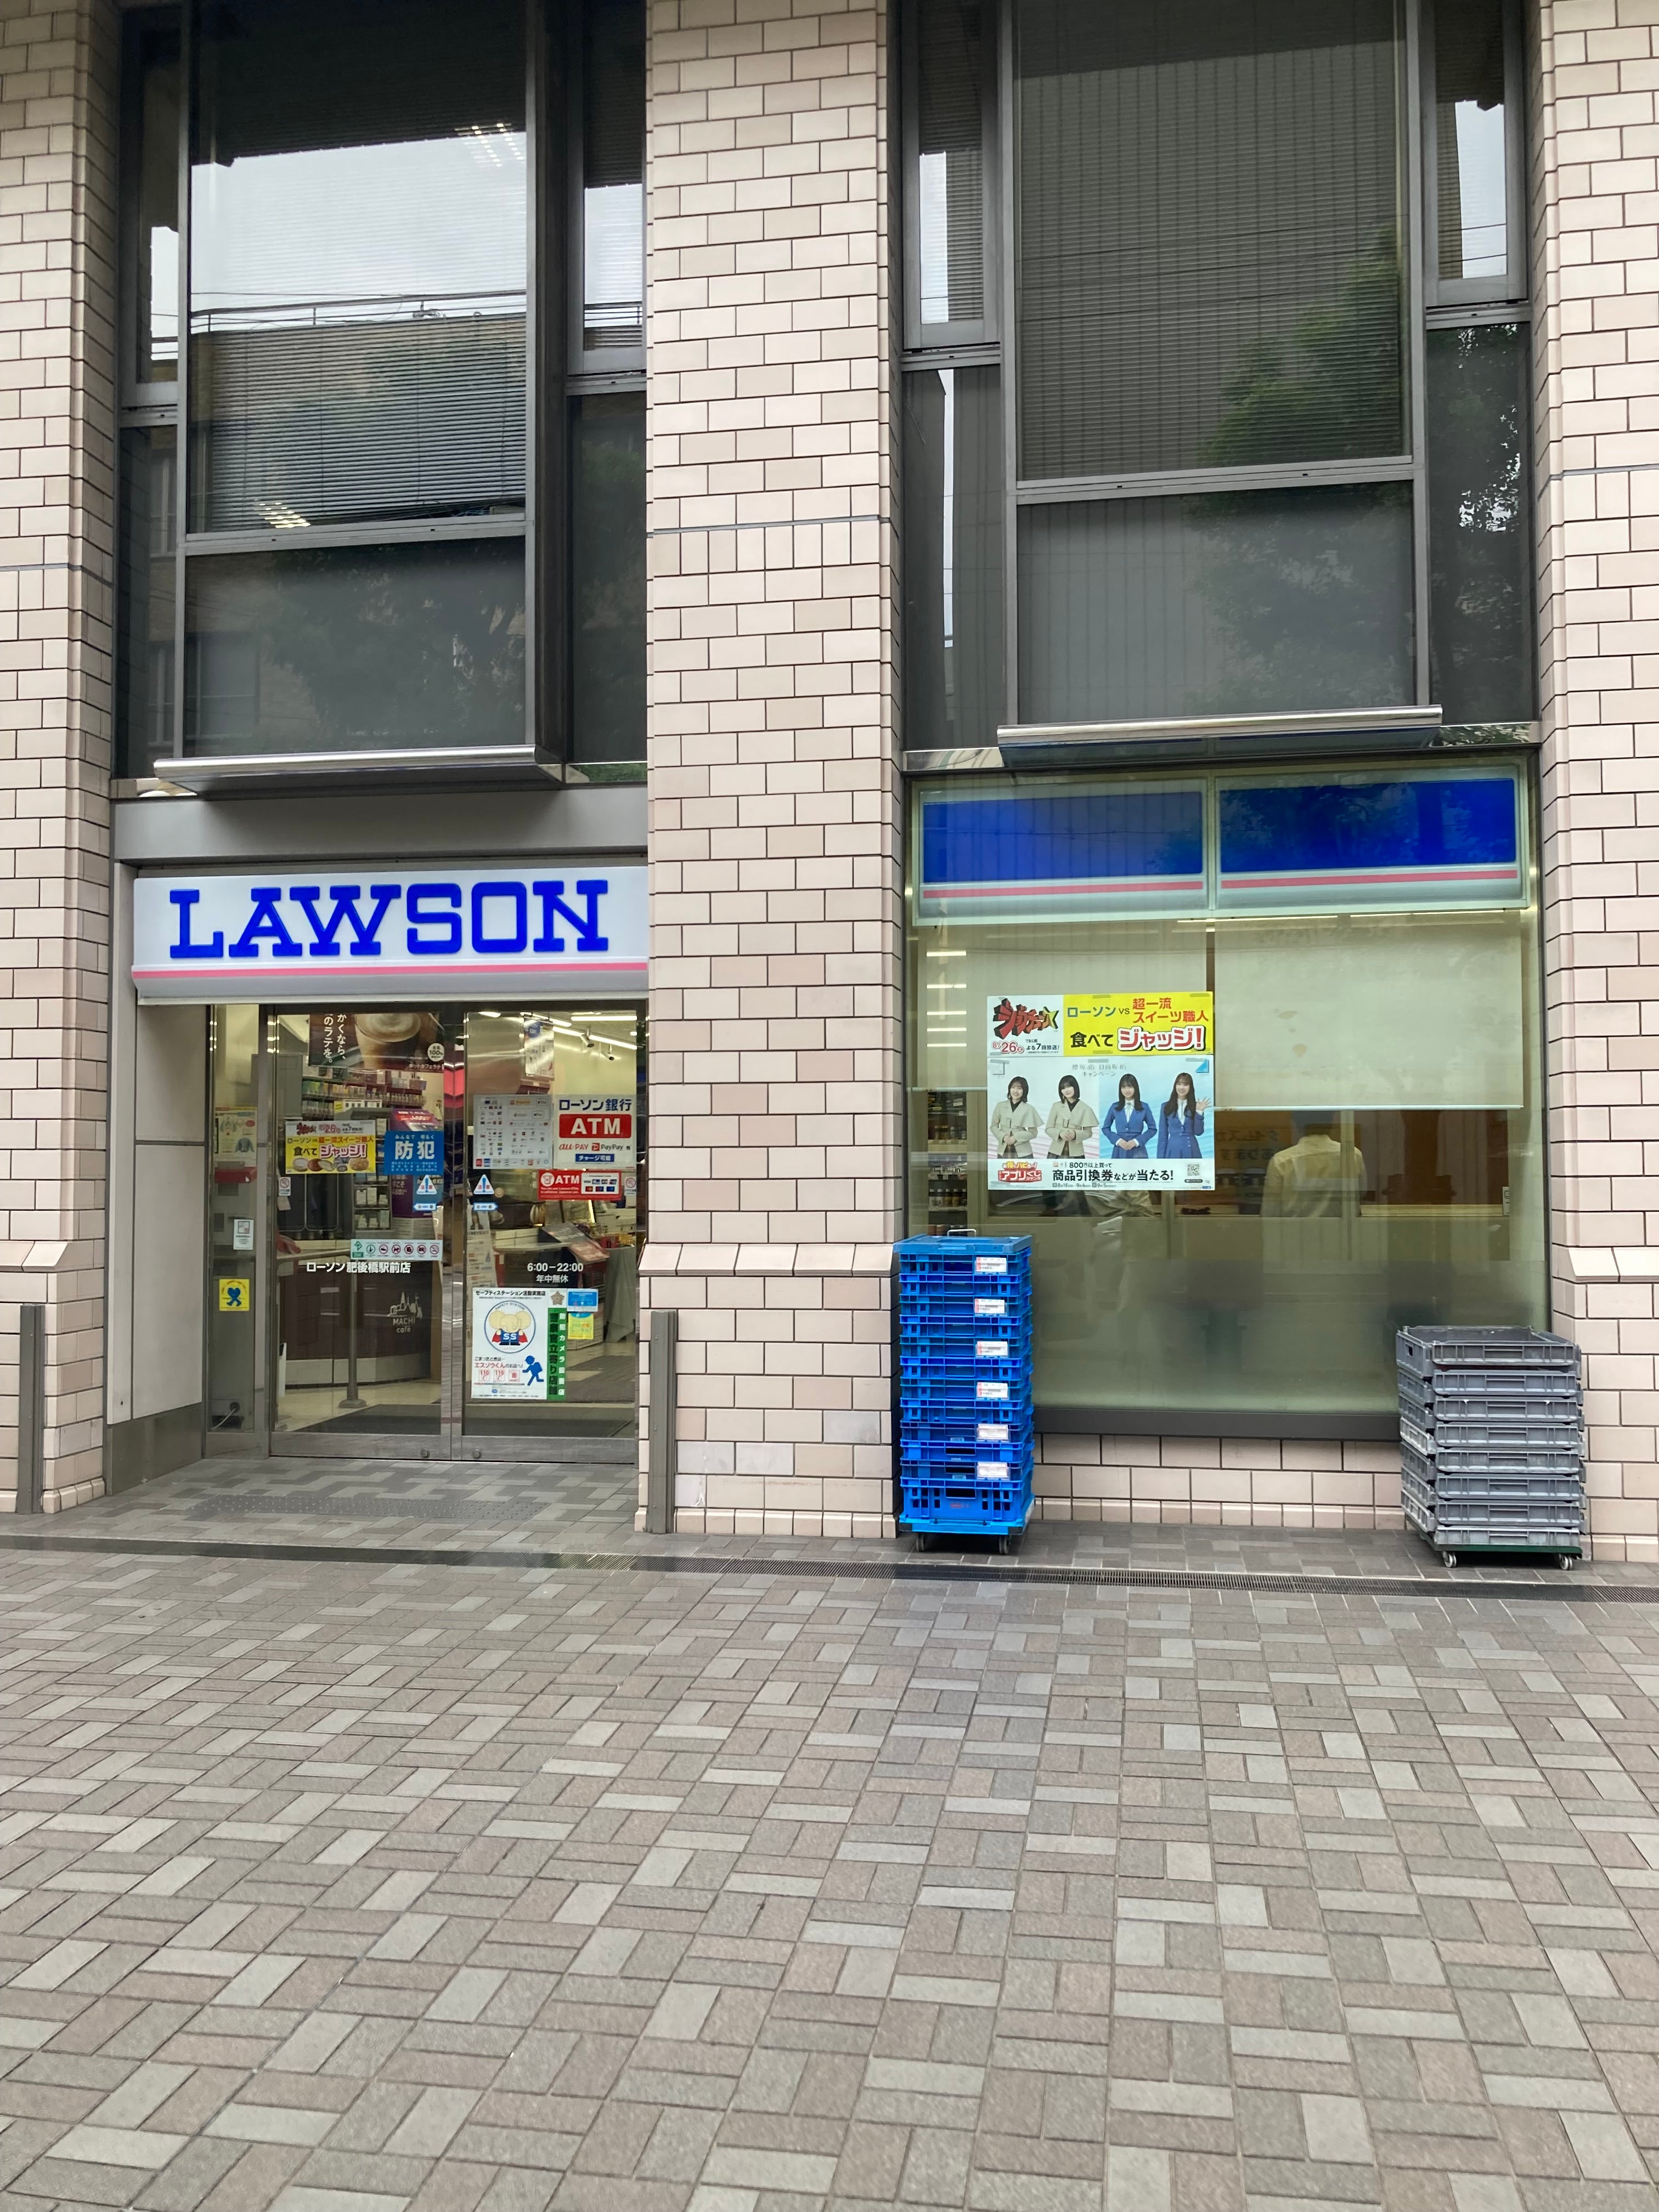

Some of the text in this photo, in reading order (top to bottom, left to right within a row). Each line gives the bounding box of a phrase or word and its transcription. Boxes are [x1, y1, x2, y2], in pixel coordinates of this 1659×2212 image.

[169, 879, 609, 958] LAWSON
[1132, 997, 1172, 1010] 超一流
[1067, 1006, 1116, 1017] ローソン
[1132, 1010, 1209, 1024] スイーツ職人
[323, 1014, 334, 1063] のラテを。
[1070, 1031, 1114, 1048] 食べて
[1119, 1027, 1203, 1048] ジャッジ!
[559, 1099, 631, 1111] ローソン銀行
[571, 1118, 620, 1135] ATM
[294, 1146, 318, 1156] 食べて
[395, 1141, 435, 1160] 防犯
[555, 1175, 580, 1184] ATM
[1052, 1169, 1173, 1181] 商品引換券などが当たる!
[536, 1274, 569, 1283] 年中無休
[393, 1317, 415, 1325] MACHI
